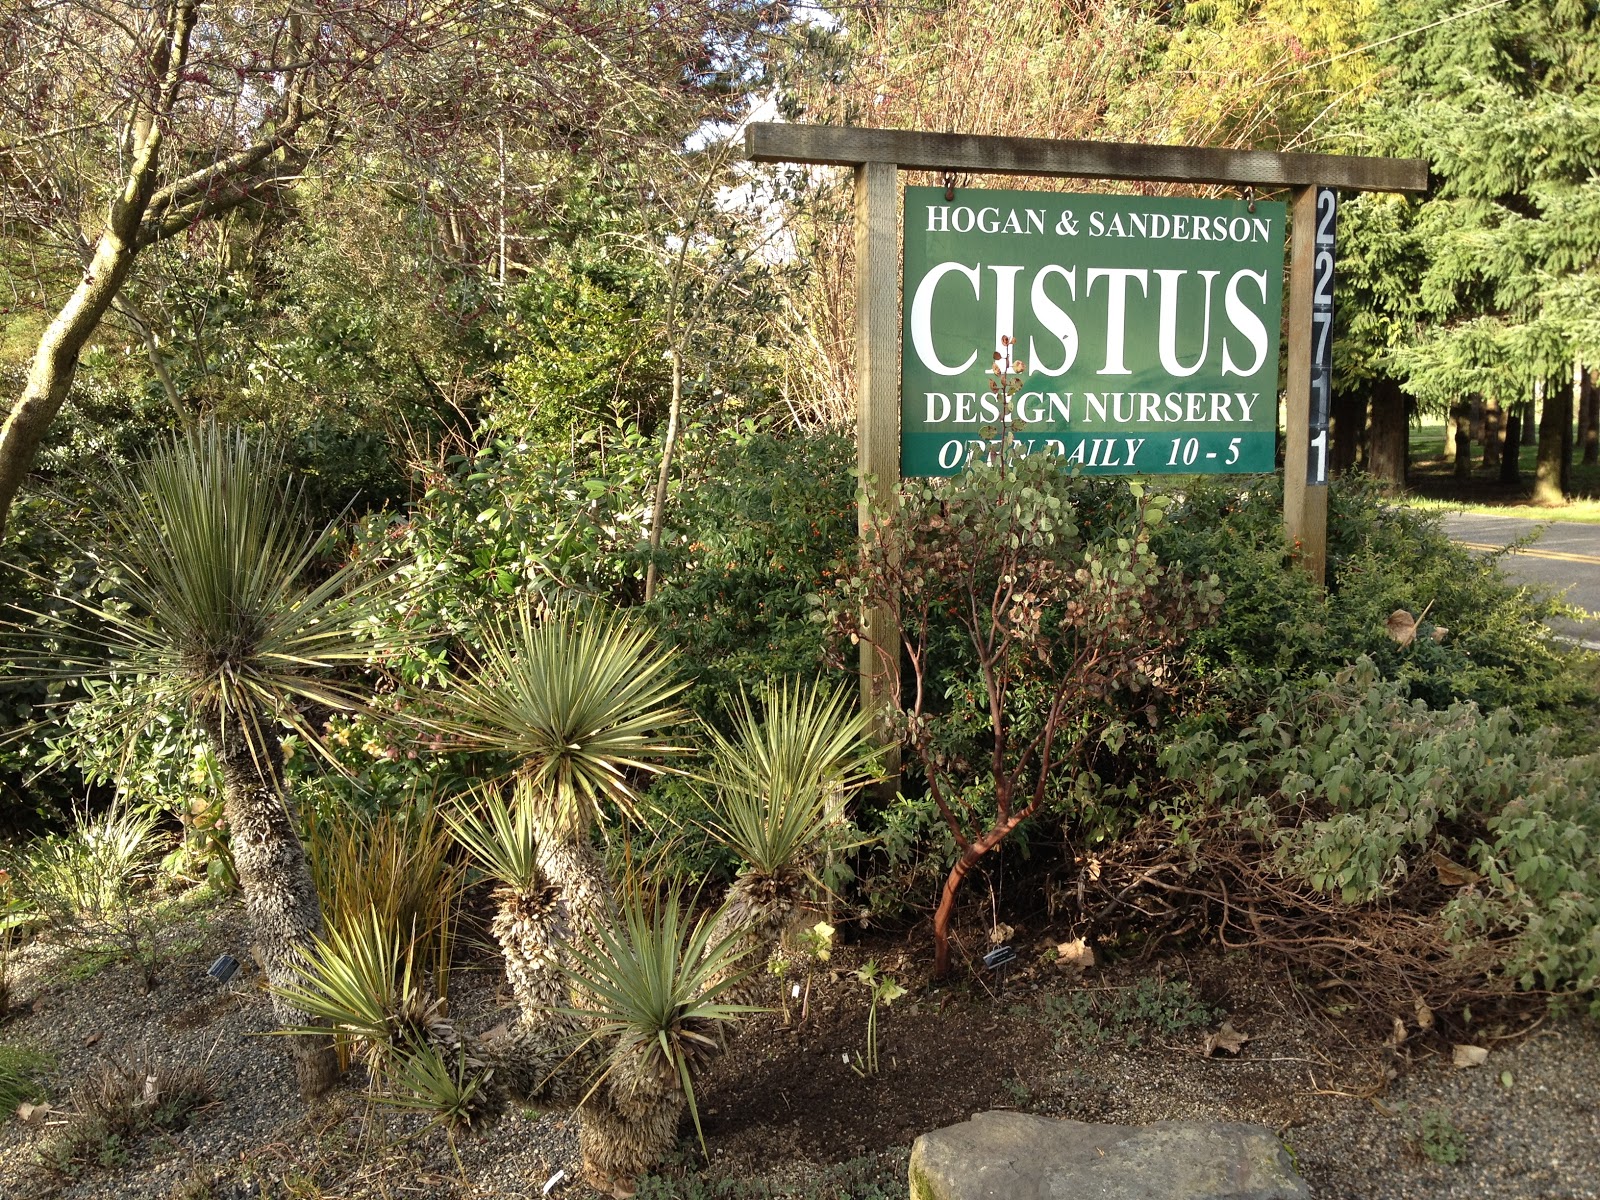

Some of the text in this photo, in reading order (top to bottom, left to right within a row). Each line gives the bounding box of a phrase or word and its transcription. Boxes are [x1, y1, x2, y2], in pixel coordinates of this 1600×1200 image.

[925, 205, 1272, 243] HOGAN & SANDERSON
[910, 261, 1269, 377] CISTUS
[1309, 190, 1336, 482] 22711
[923, 392, 1259, 423] DESIGN NURSERY
[1166, 437, 1200, 466] 10
[1225, 437, 1242, 466] 5
